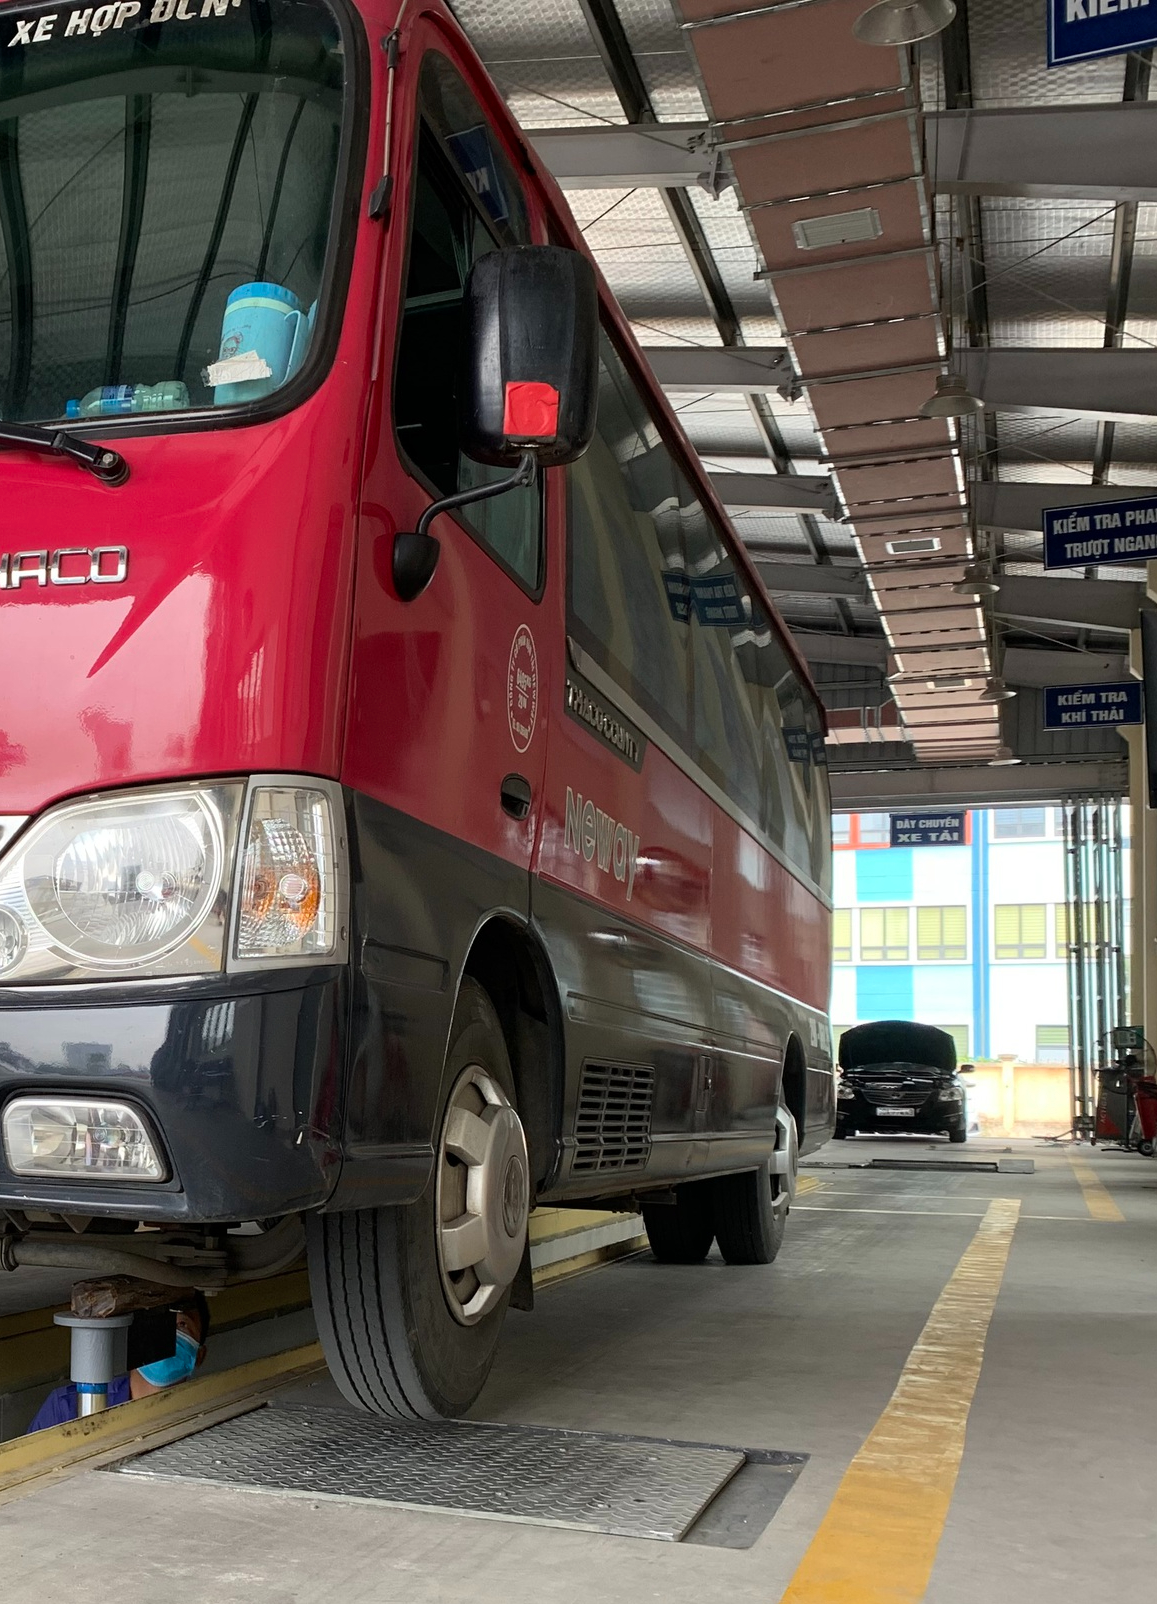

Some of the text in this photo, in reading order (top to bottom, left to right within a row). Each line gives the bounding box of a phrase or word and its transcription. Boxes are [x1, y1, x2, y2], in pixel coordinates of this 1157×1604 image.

[7, 14, 58, 47] XE
[64, 1, 141, 37] HỢP
[1053, 508, 1157, 535] KIỂM TRA PHA
[1065, 534, 1157, 559] TRƯỢT NGAN
[1057, 689, 1128, 706] KIỂM TRA
[1061, 709, 1087, 723] KHÍ
[896, 819, 917, 829] DÂY
[897, 833, 923, 843] XE
